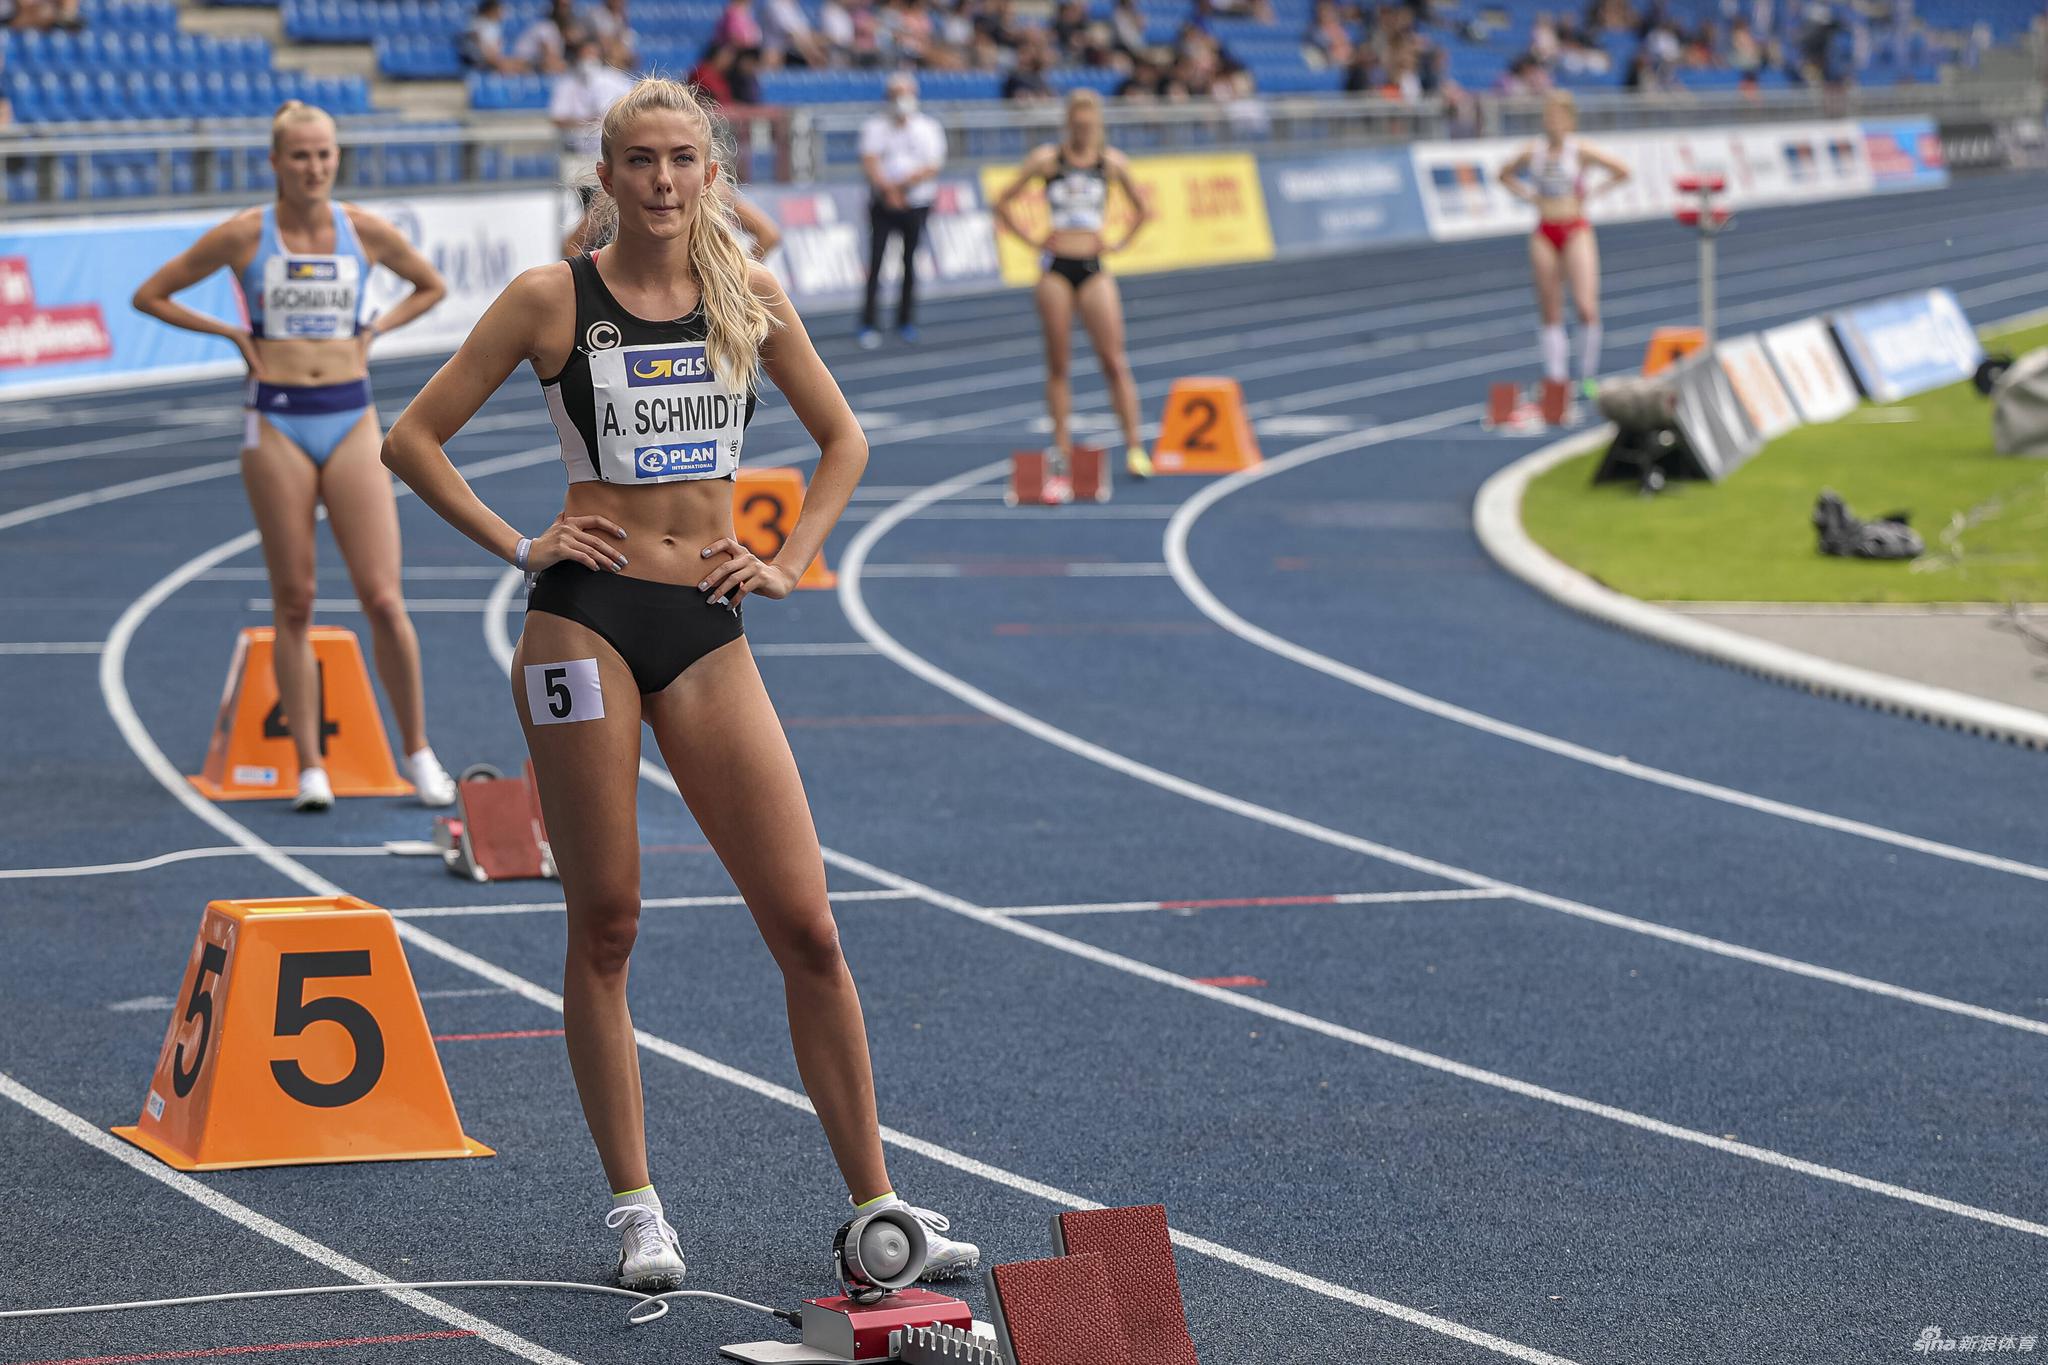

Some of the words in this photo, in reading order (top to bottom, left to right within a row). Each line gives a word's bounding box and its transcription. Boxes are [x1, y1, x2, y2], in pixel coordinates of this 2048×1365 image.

[672, 357, 706, 377] GLS
[602, 402, 627, 437] A.
[634, 393, 743, 436] SCHMIDT
[1182, 399, 1219, 451] 2
[670, 447, 714, 464] PLAN
[671, 462, 713, 471] INTERNATIONAL
[730, 439, 739, 458] 307
[740, 492, 786, 559] 3
[544, 668, 572, 719] 5
[173, 942, 227, 1098] 5
[270, 950, 385, 1108] 5
